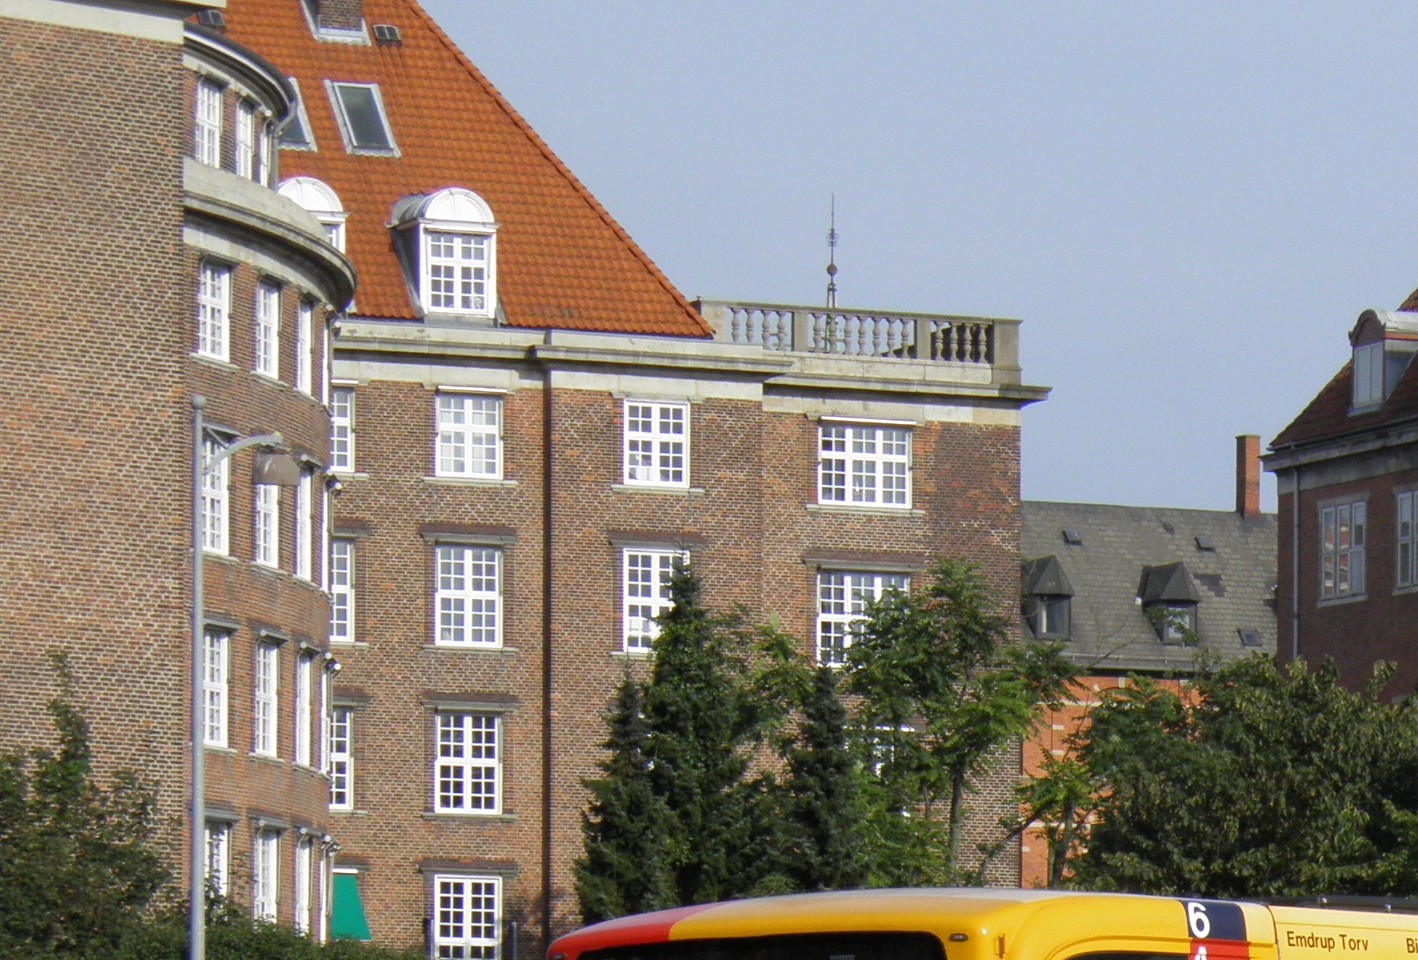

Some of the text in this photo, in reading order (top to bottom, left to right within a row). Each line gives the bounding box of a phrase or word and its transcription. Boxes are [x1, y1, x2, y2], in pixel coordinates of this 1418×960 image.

[1187, 902, 1210, 938] 6
[1286, 930, 1369, 953] Emdrup Torv
